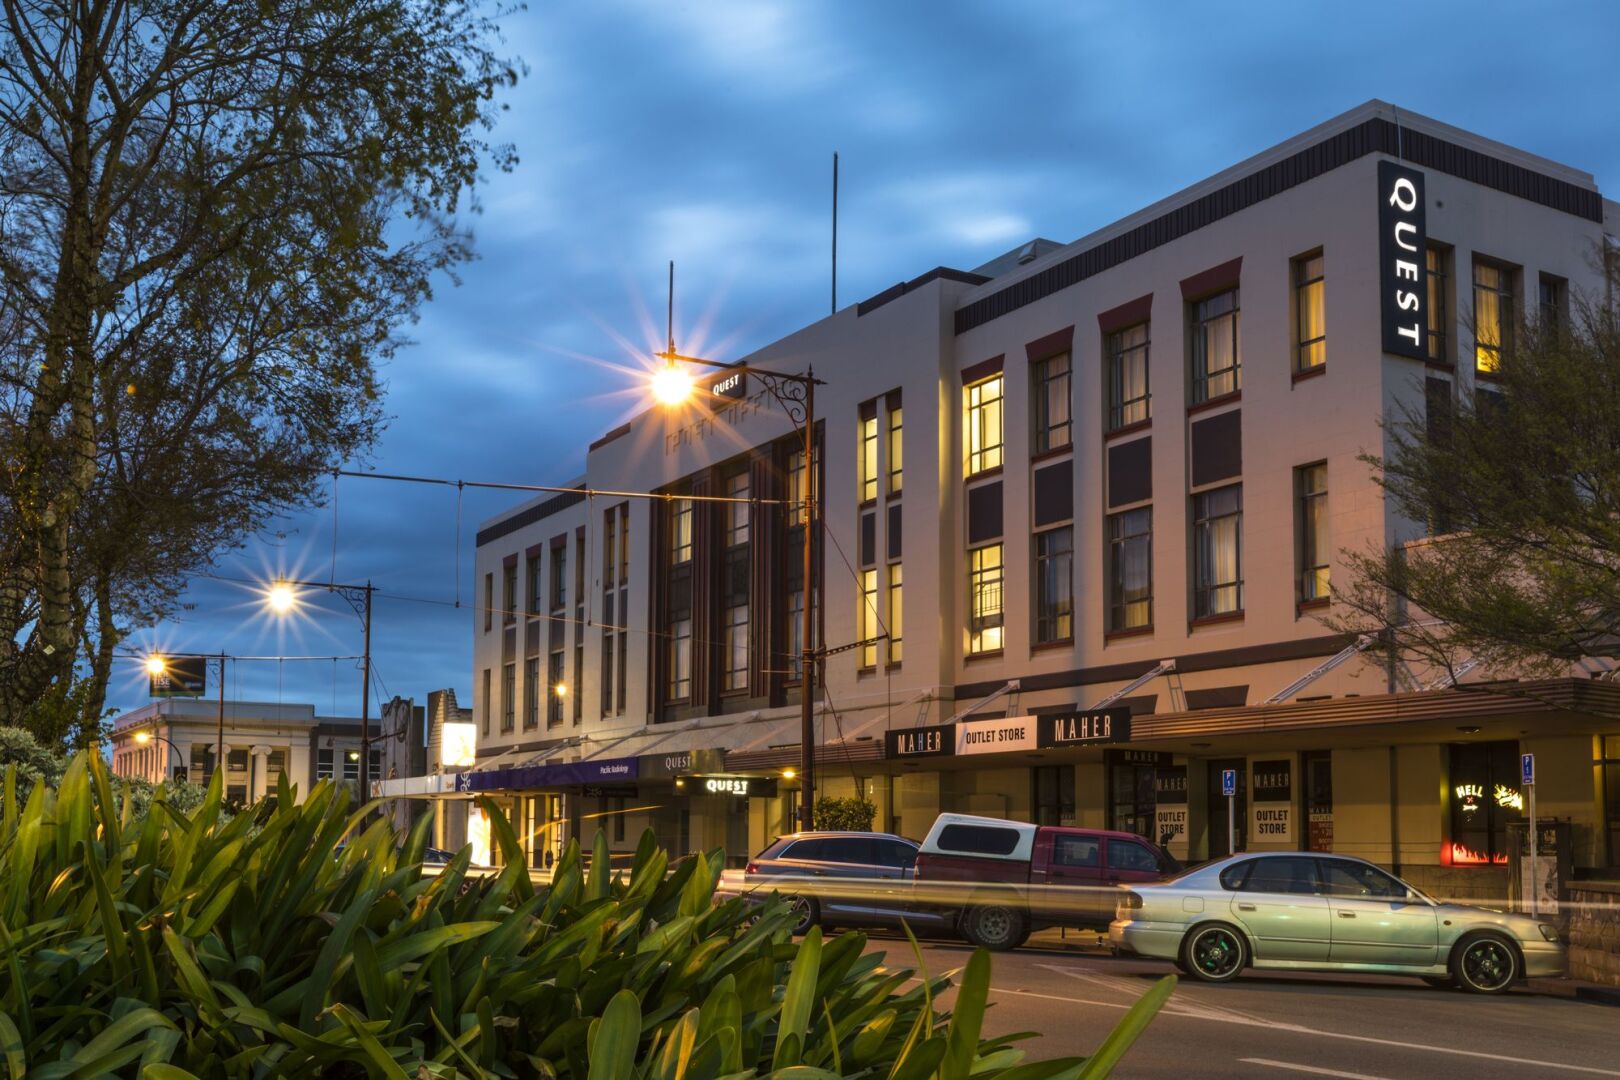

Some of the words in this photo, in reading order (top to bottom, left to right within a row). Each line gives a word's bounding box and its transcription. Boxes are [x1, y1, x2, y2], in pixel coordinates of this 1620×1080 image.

[1390, 177, 1420, 346] QUEST
[713, 374, 740, 396] QUEST
[966, 730, 996, 744] OUTLET
[999, 727, 1025, 741] STORE
[1055, 715, 1111, 742] MAHER
[897, 731, 941, 754] MAHER
[665, 755, 691, 770] QUEST
[706, 779, 748, 794] QUEST
[1156, 777, 1187, 791] MAHER
[1254, 773, 1289, 788] MAHER
[1456, 785, 1483, 799] HELL
[1158, 812, 1185, 822] OUTLET
[1257, 811, 1288, 821] OUTLET
[1160, 824, 1184, 833] STORE
[1259, 824, 1286, 834] STORE
